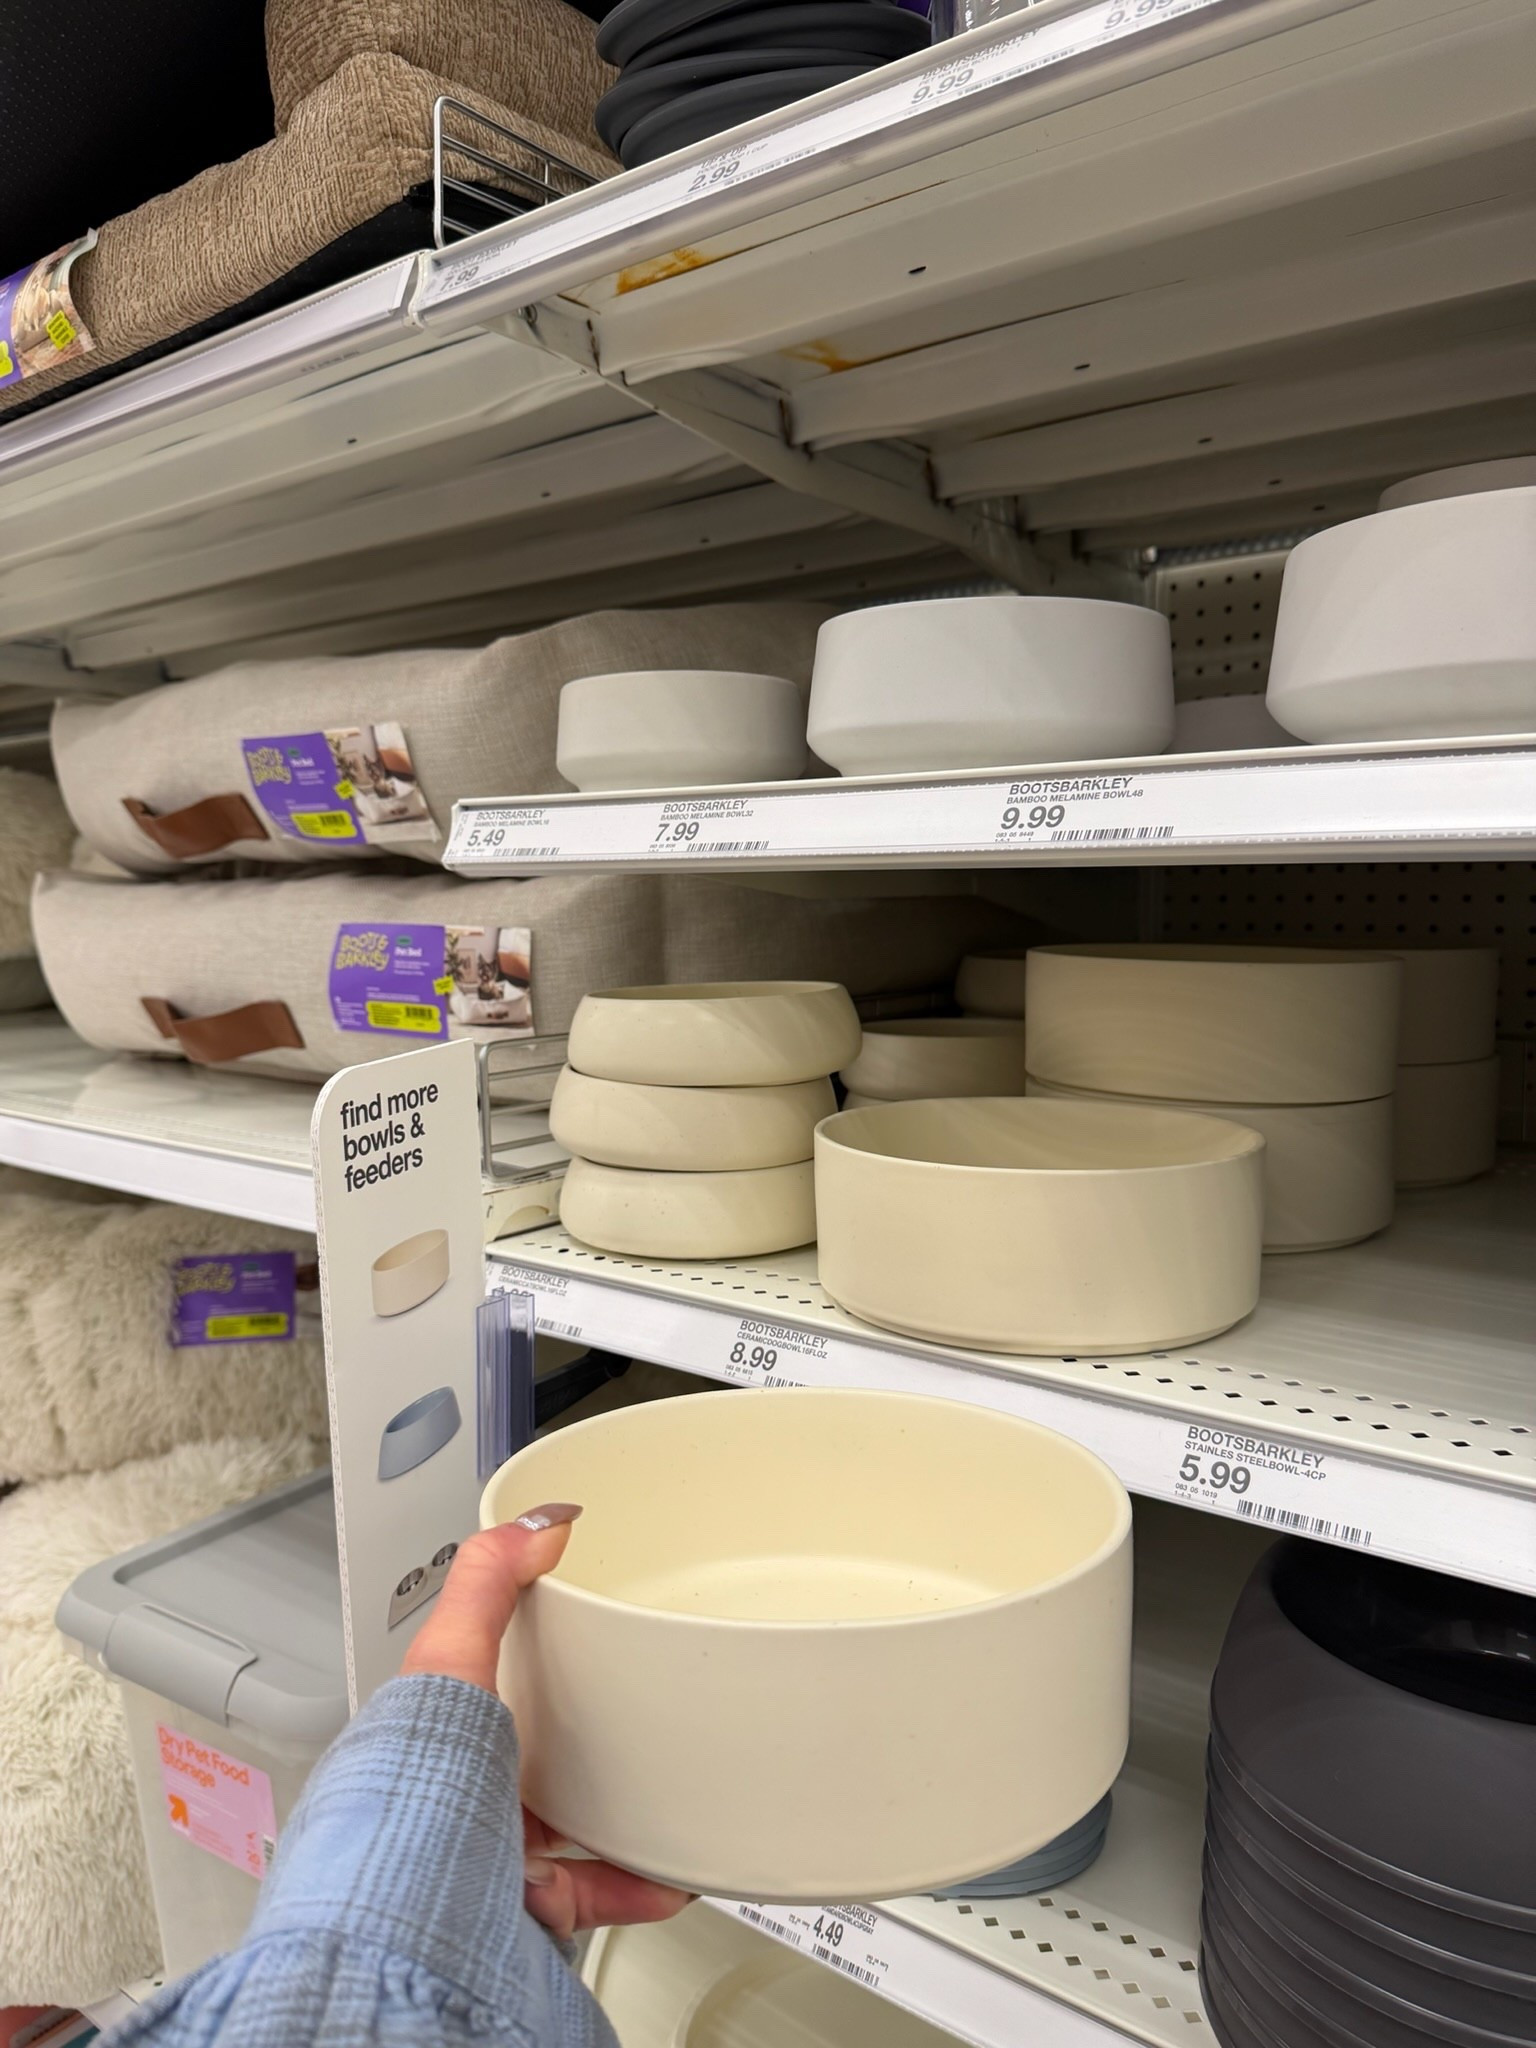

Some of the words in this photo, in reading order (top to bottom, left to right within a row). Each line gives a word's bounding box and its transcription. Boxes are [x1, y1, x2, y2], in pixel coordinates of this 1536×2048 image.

[911, 68, 974, 105] 9.99
[687, 159, 740, 193] 2.99
[440, 264, 480, 292] 7.99
[1006, 794, 1048, 805] BAMBOO
[1049, 791, 1101, 803] MELAMINE
[1102, 788, 1144, 800] BOWL48
[1009, 776, 1133, 796] BOOTSBARKLEY
[476, 809, 546, 821] BOOTSBARKLEY
[660, 813, 689, 821] BAMBOO
[689, 811, 724, 820] MELAMINE
[725, 810, 754, 819] BOWL32
[663, 799, 749, 814] BOOTSBARKLEY
[1000, 804, 1066, 830] 9.99
[467, 829, 505, 847] 5.49
[655, 821, 700, 842] 7.99
[340, 1092, 382, 1130] find
[387, 1083, 438, 1116] more
[343, 1120, 406, 1162] bowls
[410, 1111, 426, 1138] &
[344, 1147, 423, 1193] feeders
[501, 1265, 570, 1289] BOOTSBARKLEY
[740, 1319, 828, 1349] BOOTSBARKLEY
[729, 1341, 777, 1372] 8.99
[1184, 1440, 1235, 1460] STAINLES
[1235, 1452, 1327, 1482] STEELBOWL-4CP
[1187, 1425, 1325, 1469] BOOTSBARKLEY
[1179, 1453, 1251, 1495] 5.99
[161, 1746, 216, 1788] Storage
[211, 1752, 250, 1786] Food
[813, 1914, 844, 1947] 4.49
